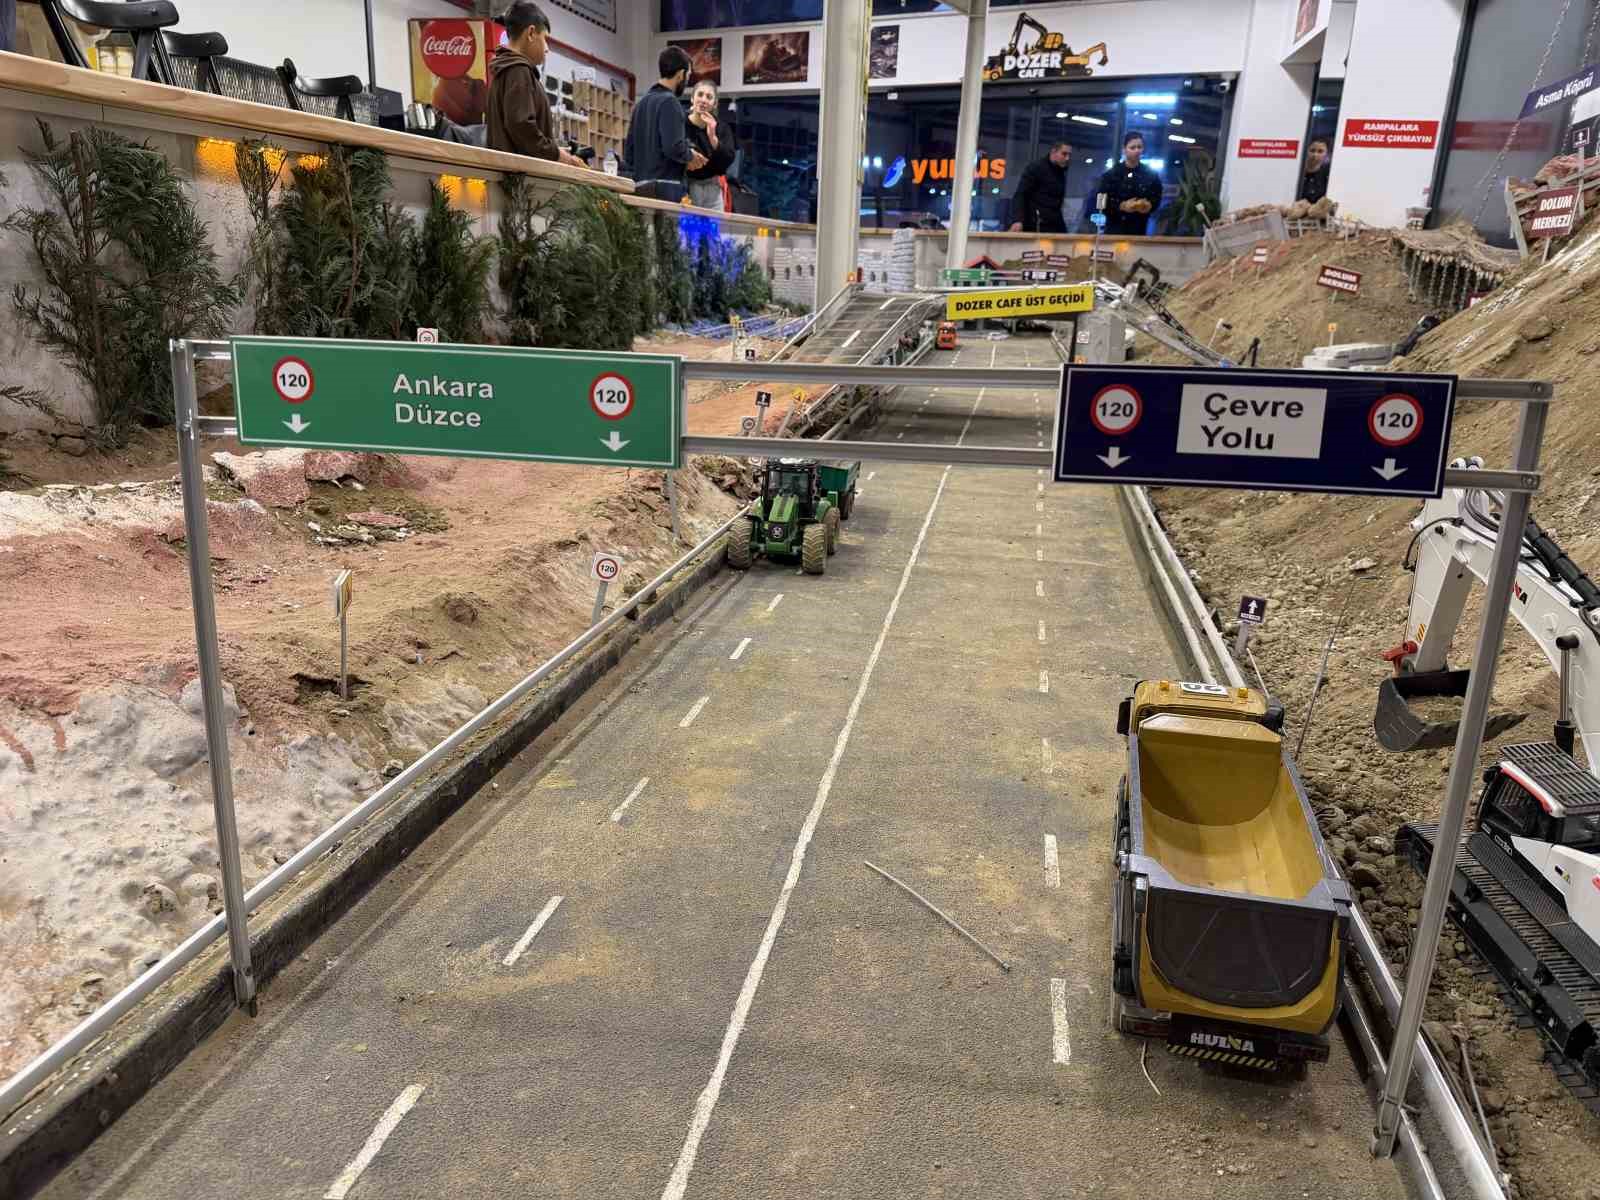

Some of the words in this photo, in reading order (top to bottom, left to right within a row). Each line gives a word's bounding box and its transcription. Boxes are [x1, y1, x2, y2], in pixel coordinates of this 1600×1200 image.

[1003, 52, 1062, 71] DOZER
[1018, 68, 1045, 78] CAFE
[1535, 89, 1563, 109] Asma
[1564, 72, 1595, 98] Köprü
[1363, 122, 1419, 132] RAMPALARA
[1540, 195, 1573, 211] DOLUM
[956, 300, 992, 311] DOZER
[997, 298, 1022, 309] CAFE
[1025, 294, 1045, 306] ÜST
[1049, 291, 1085, 307] GEÇİDİ
[278, 373, 308, 387] 120
[393, 373, 495, 399] Ankara
[595, 389, 627, 404] 120
[1098, 402, 1134, 418] 120
[1203, 392, 1304, 421] Çevre
[395, 403, 481, 428] Düzce
[1376, 411, 1414, 428] 120
[1201, 425, 1274, 450] Yolu
[601, 564, 615, 573] 120
